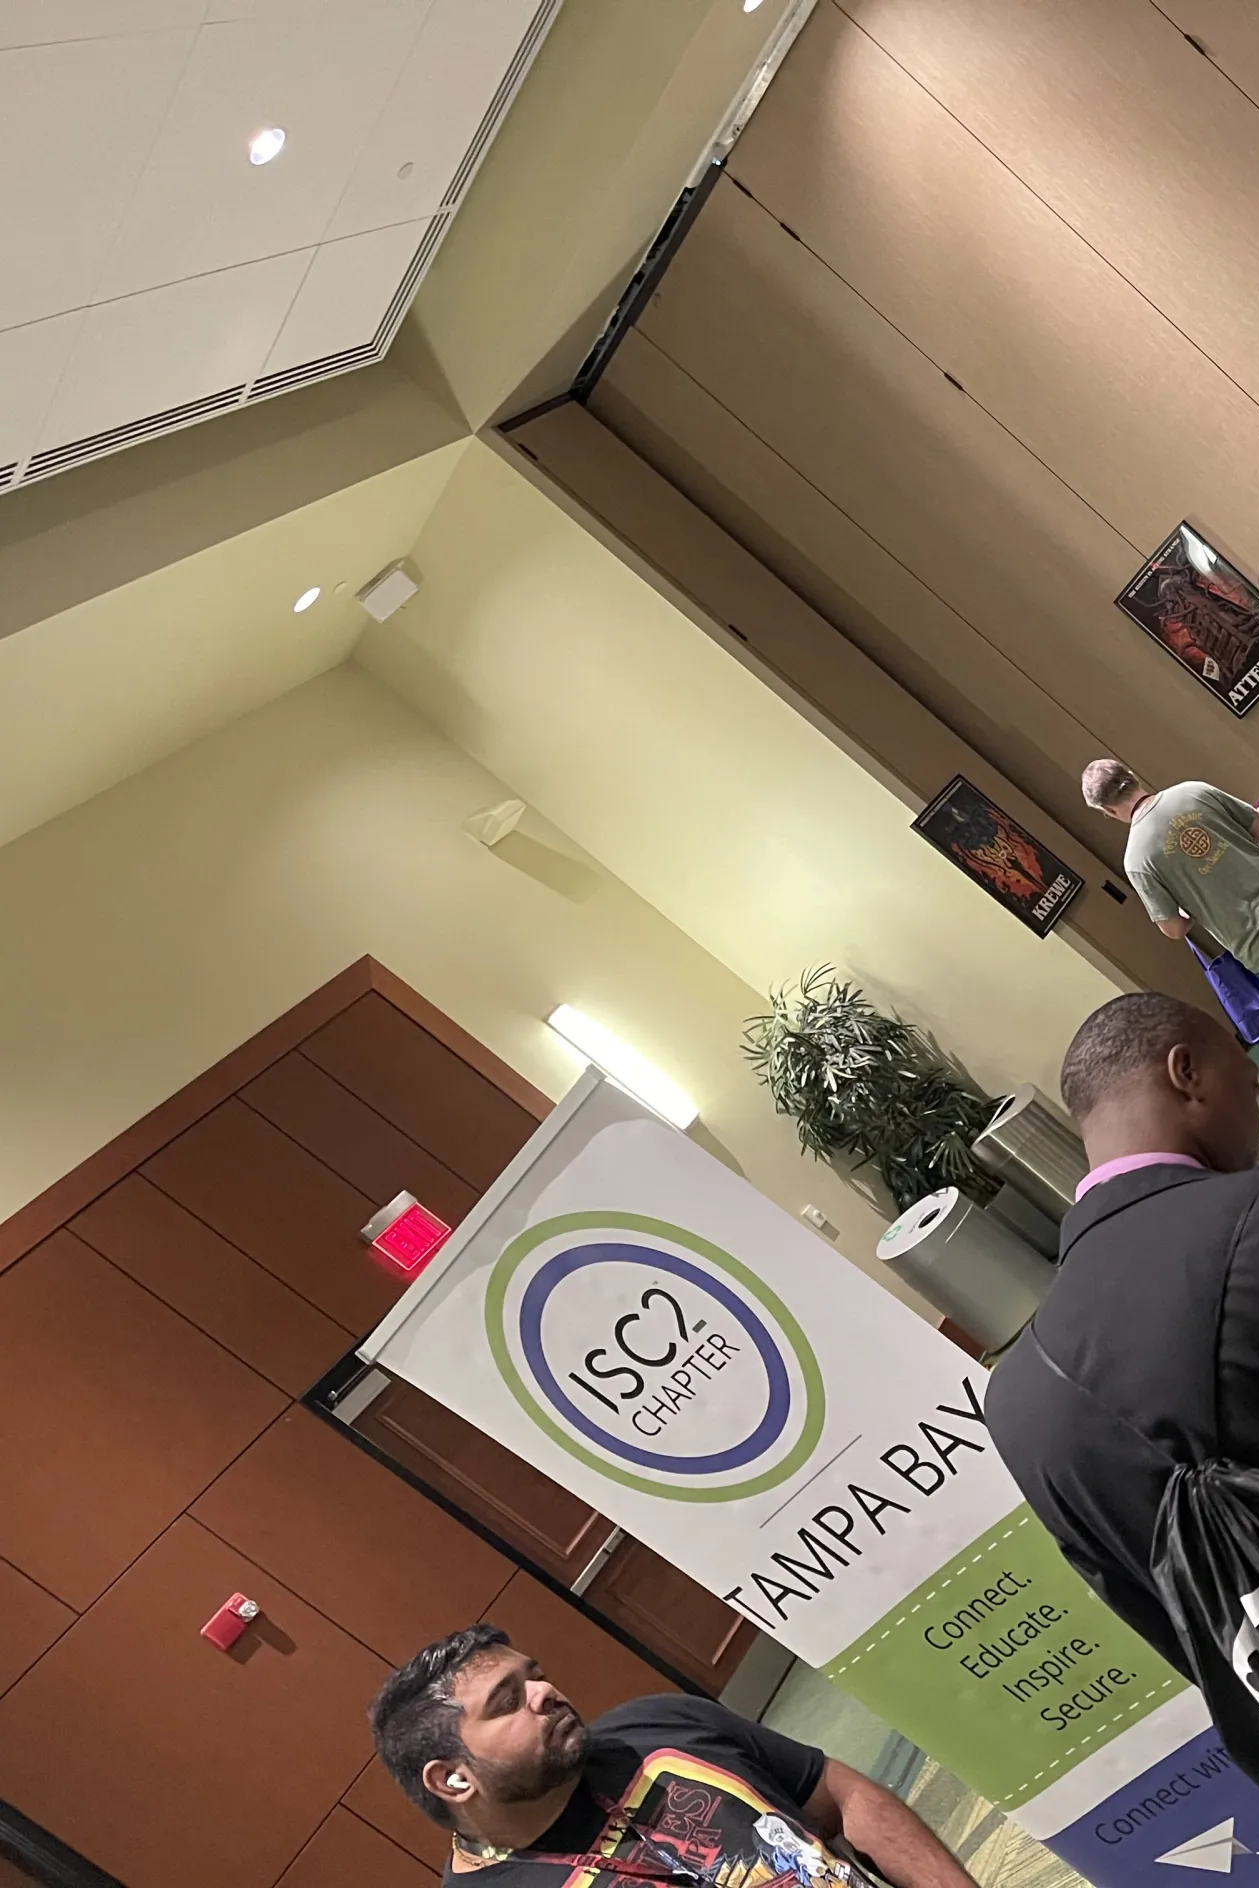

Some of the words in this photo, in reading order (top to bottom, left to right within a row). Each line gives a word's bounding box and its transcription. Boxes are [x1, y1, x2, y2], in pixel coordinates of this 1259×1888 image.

[1032, 873, 1073, 923] KREWE
[385, 1209, 441, 1260] EXIT
[568, 1288, 707, 1415] ISC2
[632, 1333, 741, 1436] CHAPTER
[723, 1484, 911, 1629] TAMPA
[880, 1376, 988, 1496] BAY
[924, 1570, 1032, 1650] Connect.
[960, 1604, 1069, 1679] Educate.
[1002, 1638, 1100, 1703] Inspire.
[1040, 1667, 1137, 1731] Secure.
[1095, 1772, 1200, 1845] Connect
